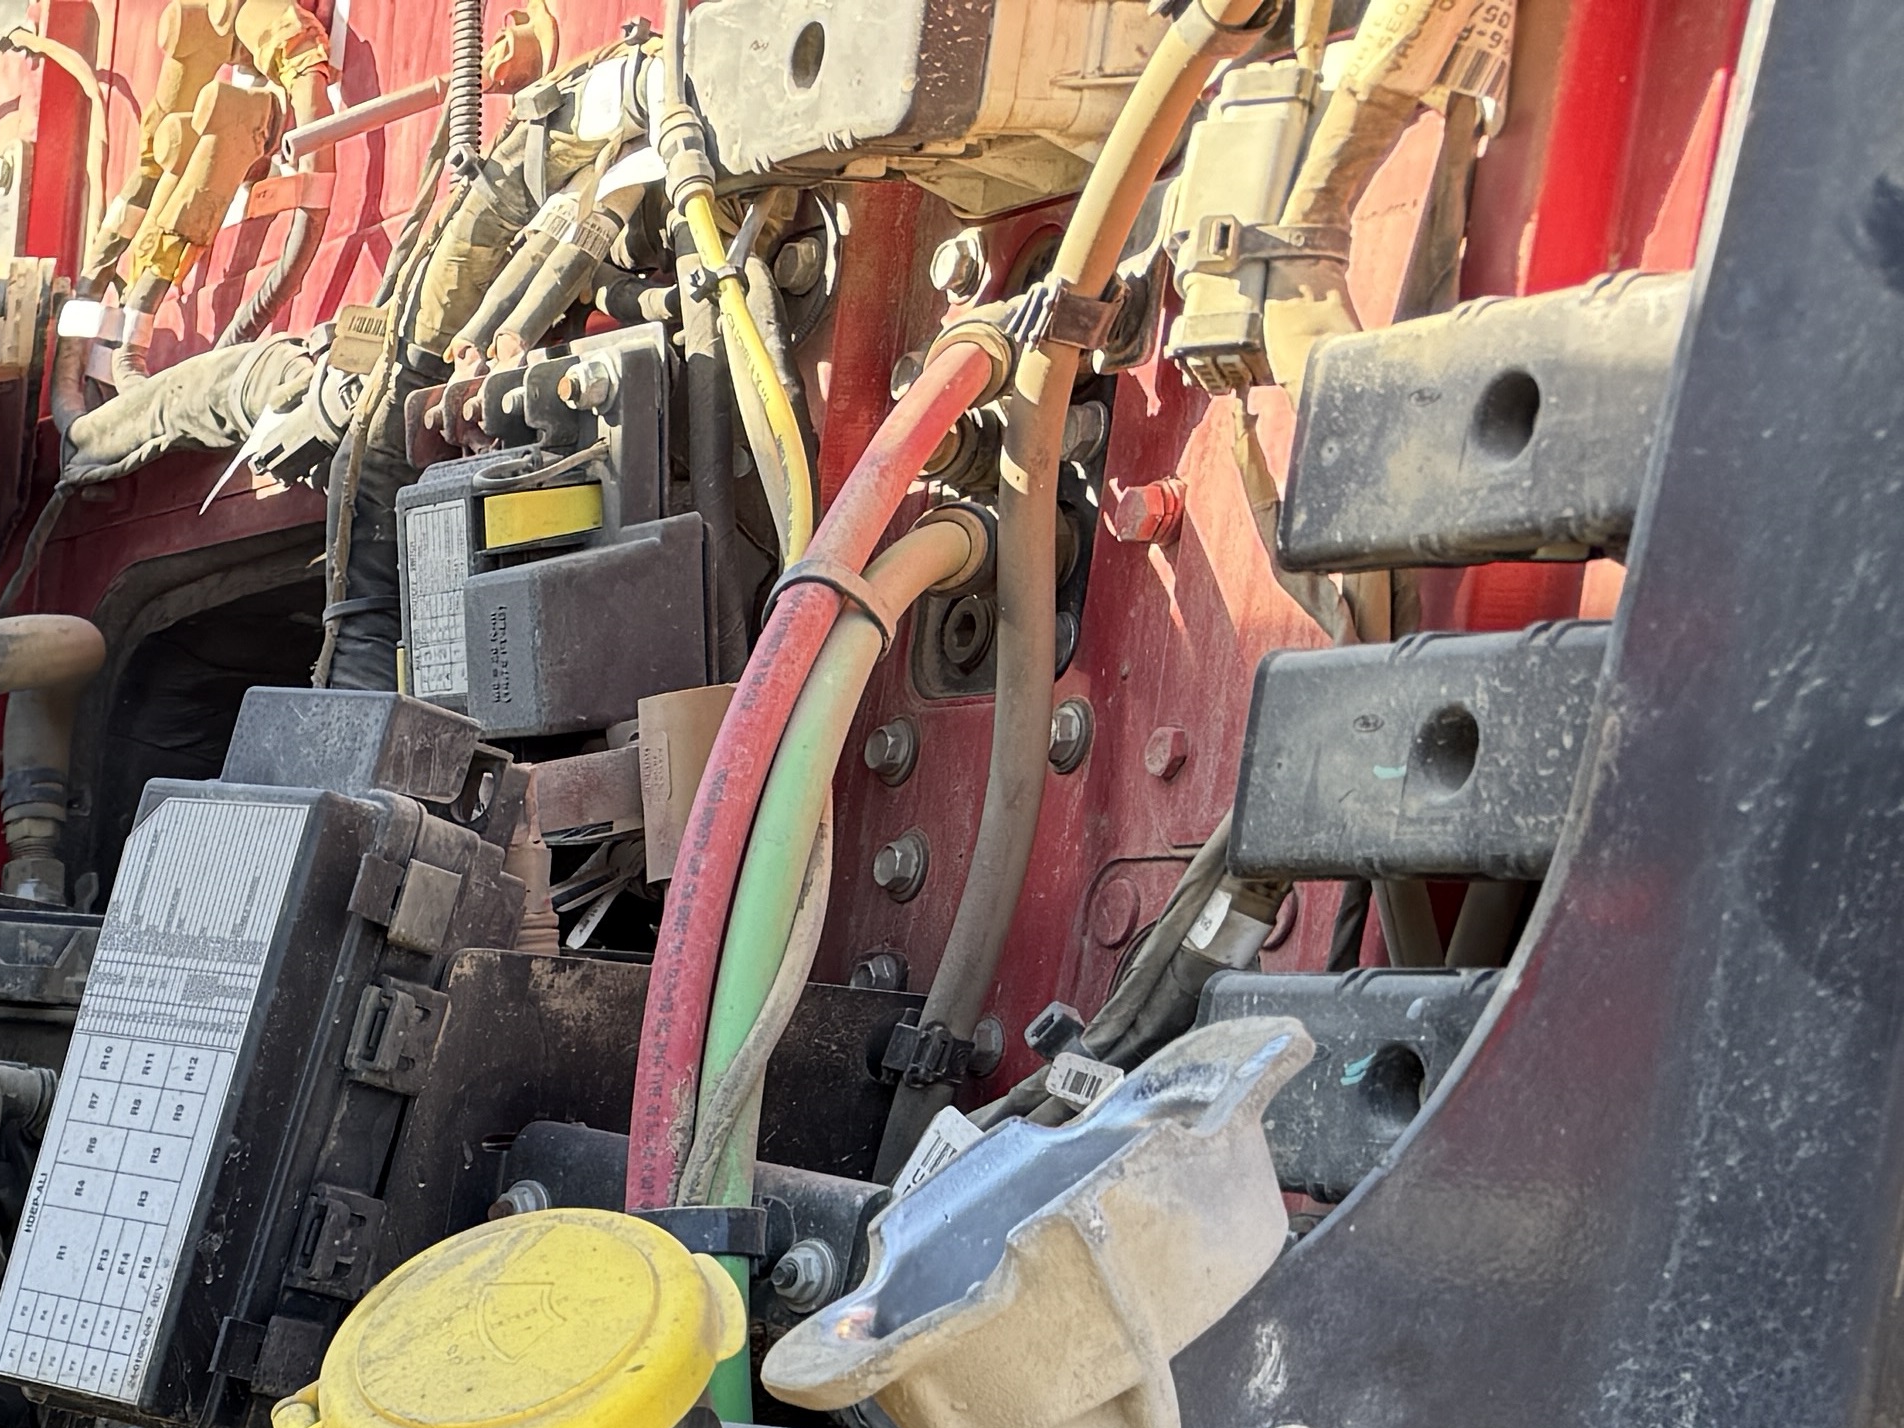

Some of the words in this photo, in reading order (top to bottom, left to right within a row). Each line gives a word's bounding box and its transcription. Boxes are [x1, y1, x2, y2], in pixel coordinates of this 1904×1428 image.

[100, 1045, 113, 1071] R10
[142, 1052, 155, 1076] R11
[184, 1056, 200, 1082] R12
[88, 1092, 100, 1110] R7
[172, 1103, 184, 1122] R9
[74, 1178, 86, 1197] R4
[137, 1190, 149, 1208] R3
[55, 1244, 68, 1261] R1
[117, 1252, 131, 1276] F14
